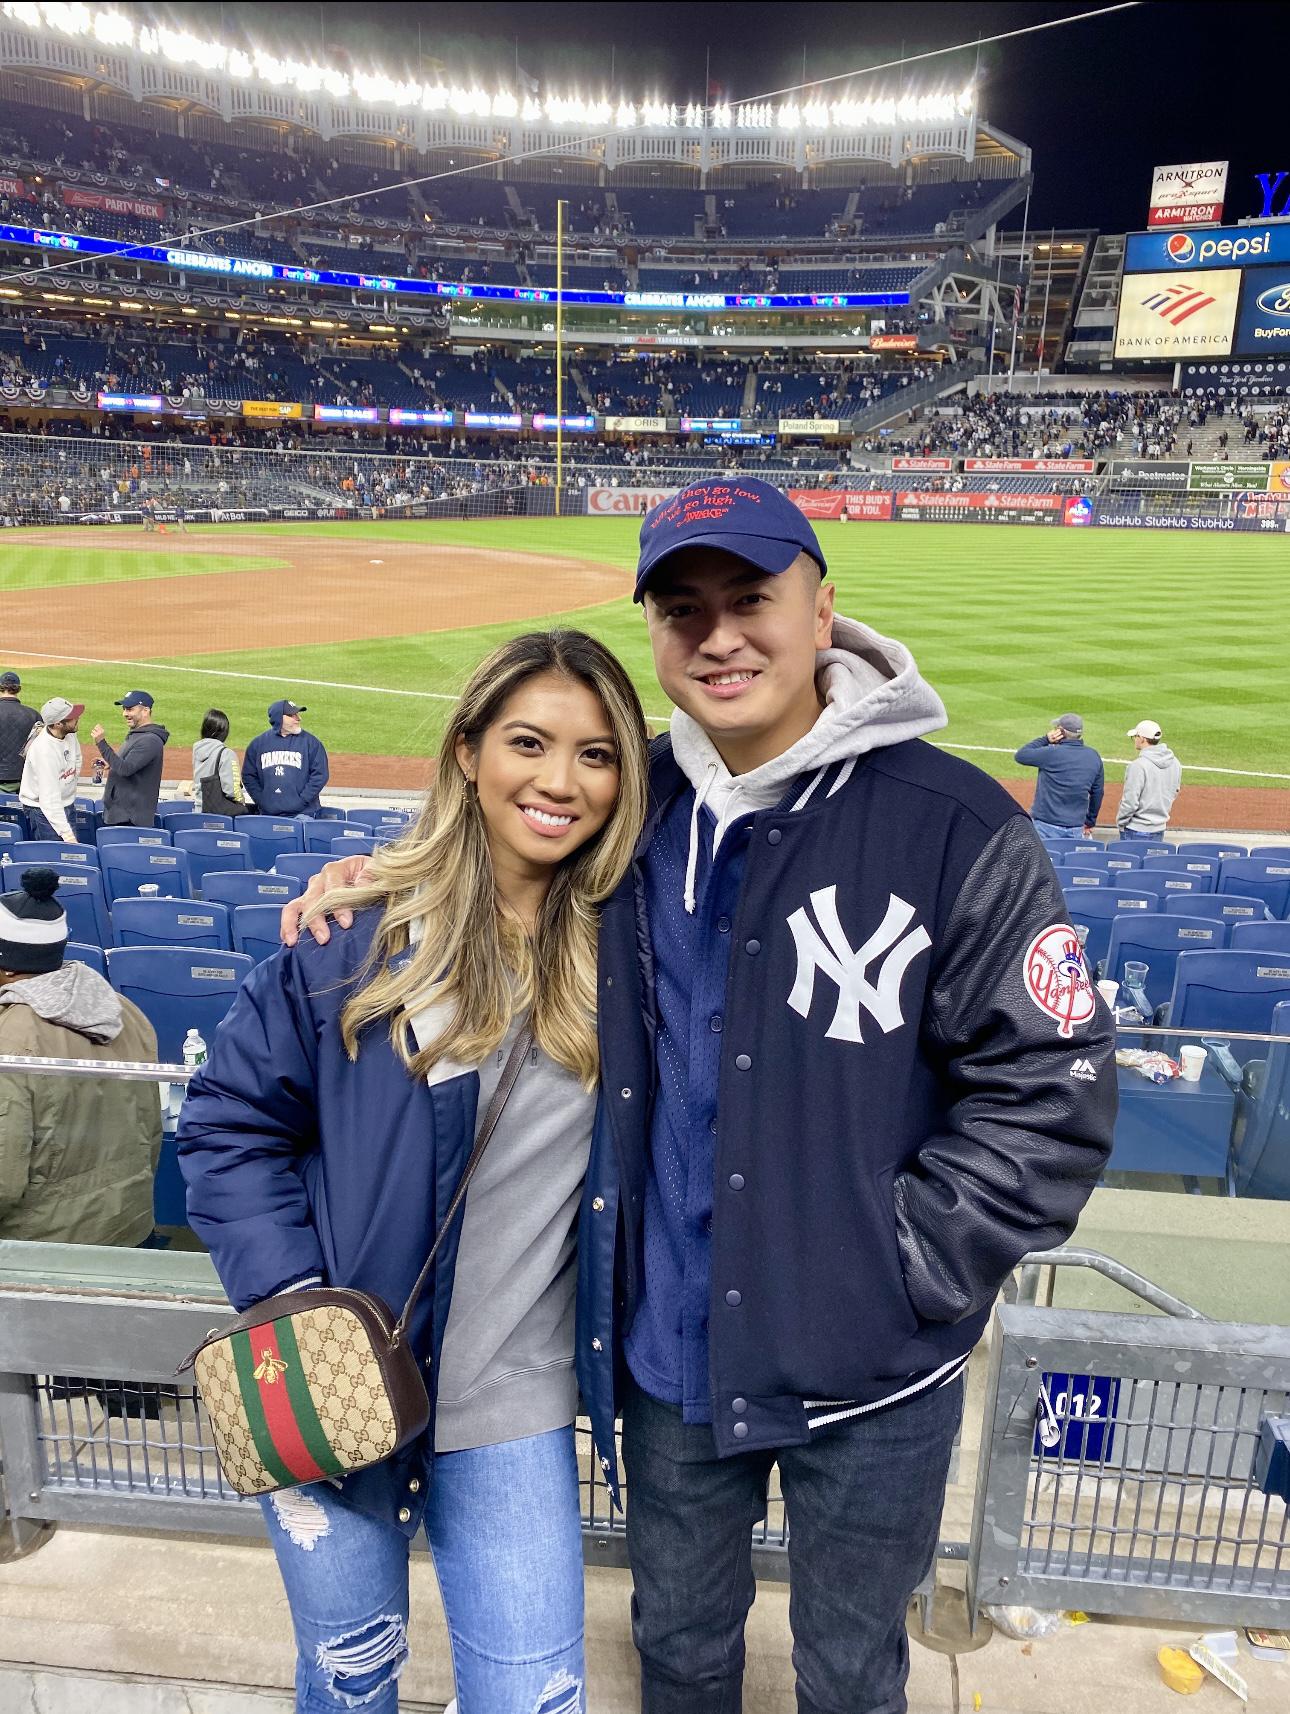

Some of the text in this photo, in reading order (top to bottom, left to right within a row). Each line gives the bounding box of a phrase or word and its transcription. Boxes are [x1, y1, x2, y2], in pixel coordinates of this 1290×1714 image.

[1156, 168, 1224, 182] ARMITRON
[105, 199, 134, 212] PARTY
[135, 203, 159, 218] DECK
[1155, 205, 1216, 219] ARMITRON
[1199, 231, 1271, 262] pepsi
[1119, 335, 1229, 346] BANK OF AMERICA
[634, 418, 659, 427] ORIS
[782, 421, 836, 433] Poland Spring
[681, 486, 711, 500] they
[711, 486, 731, 495] go
[845, 494, 890, 505] THIS BUD'S
[590, 489, 668, 512] Cano
[846, 504, 861, 515] FOR
[1099, 514, 1142, 527] StubHub
[1144, 516, 1188, 528] StubHub
[1190, 516, 1234, 529] StubHub
[260, 750, 302, 770] YANKEES
[786, 884, 933, 1045] NY
[1069, 1069, 1097, 1083] Majestic
[1055, 1392, 1102, 1418] 012
